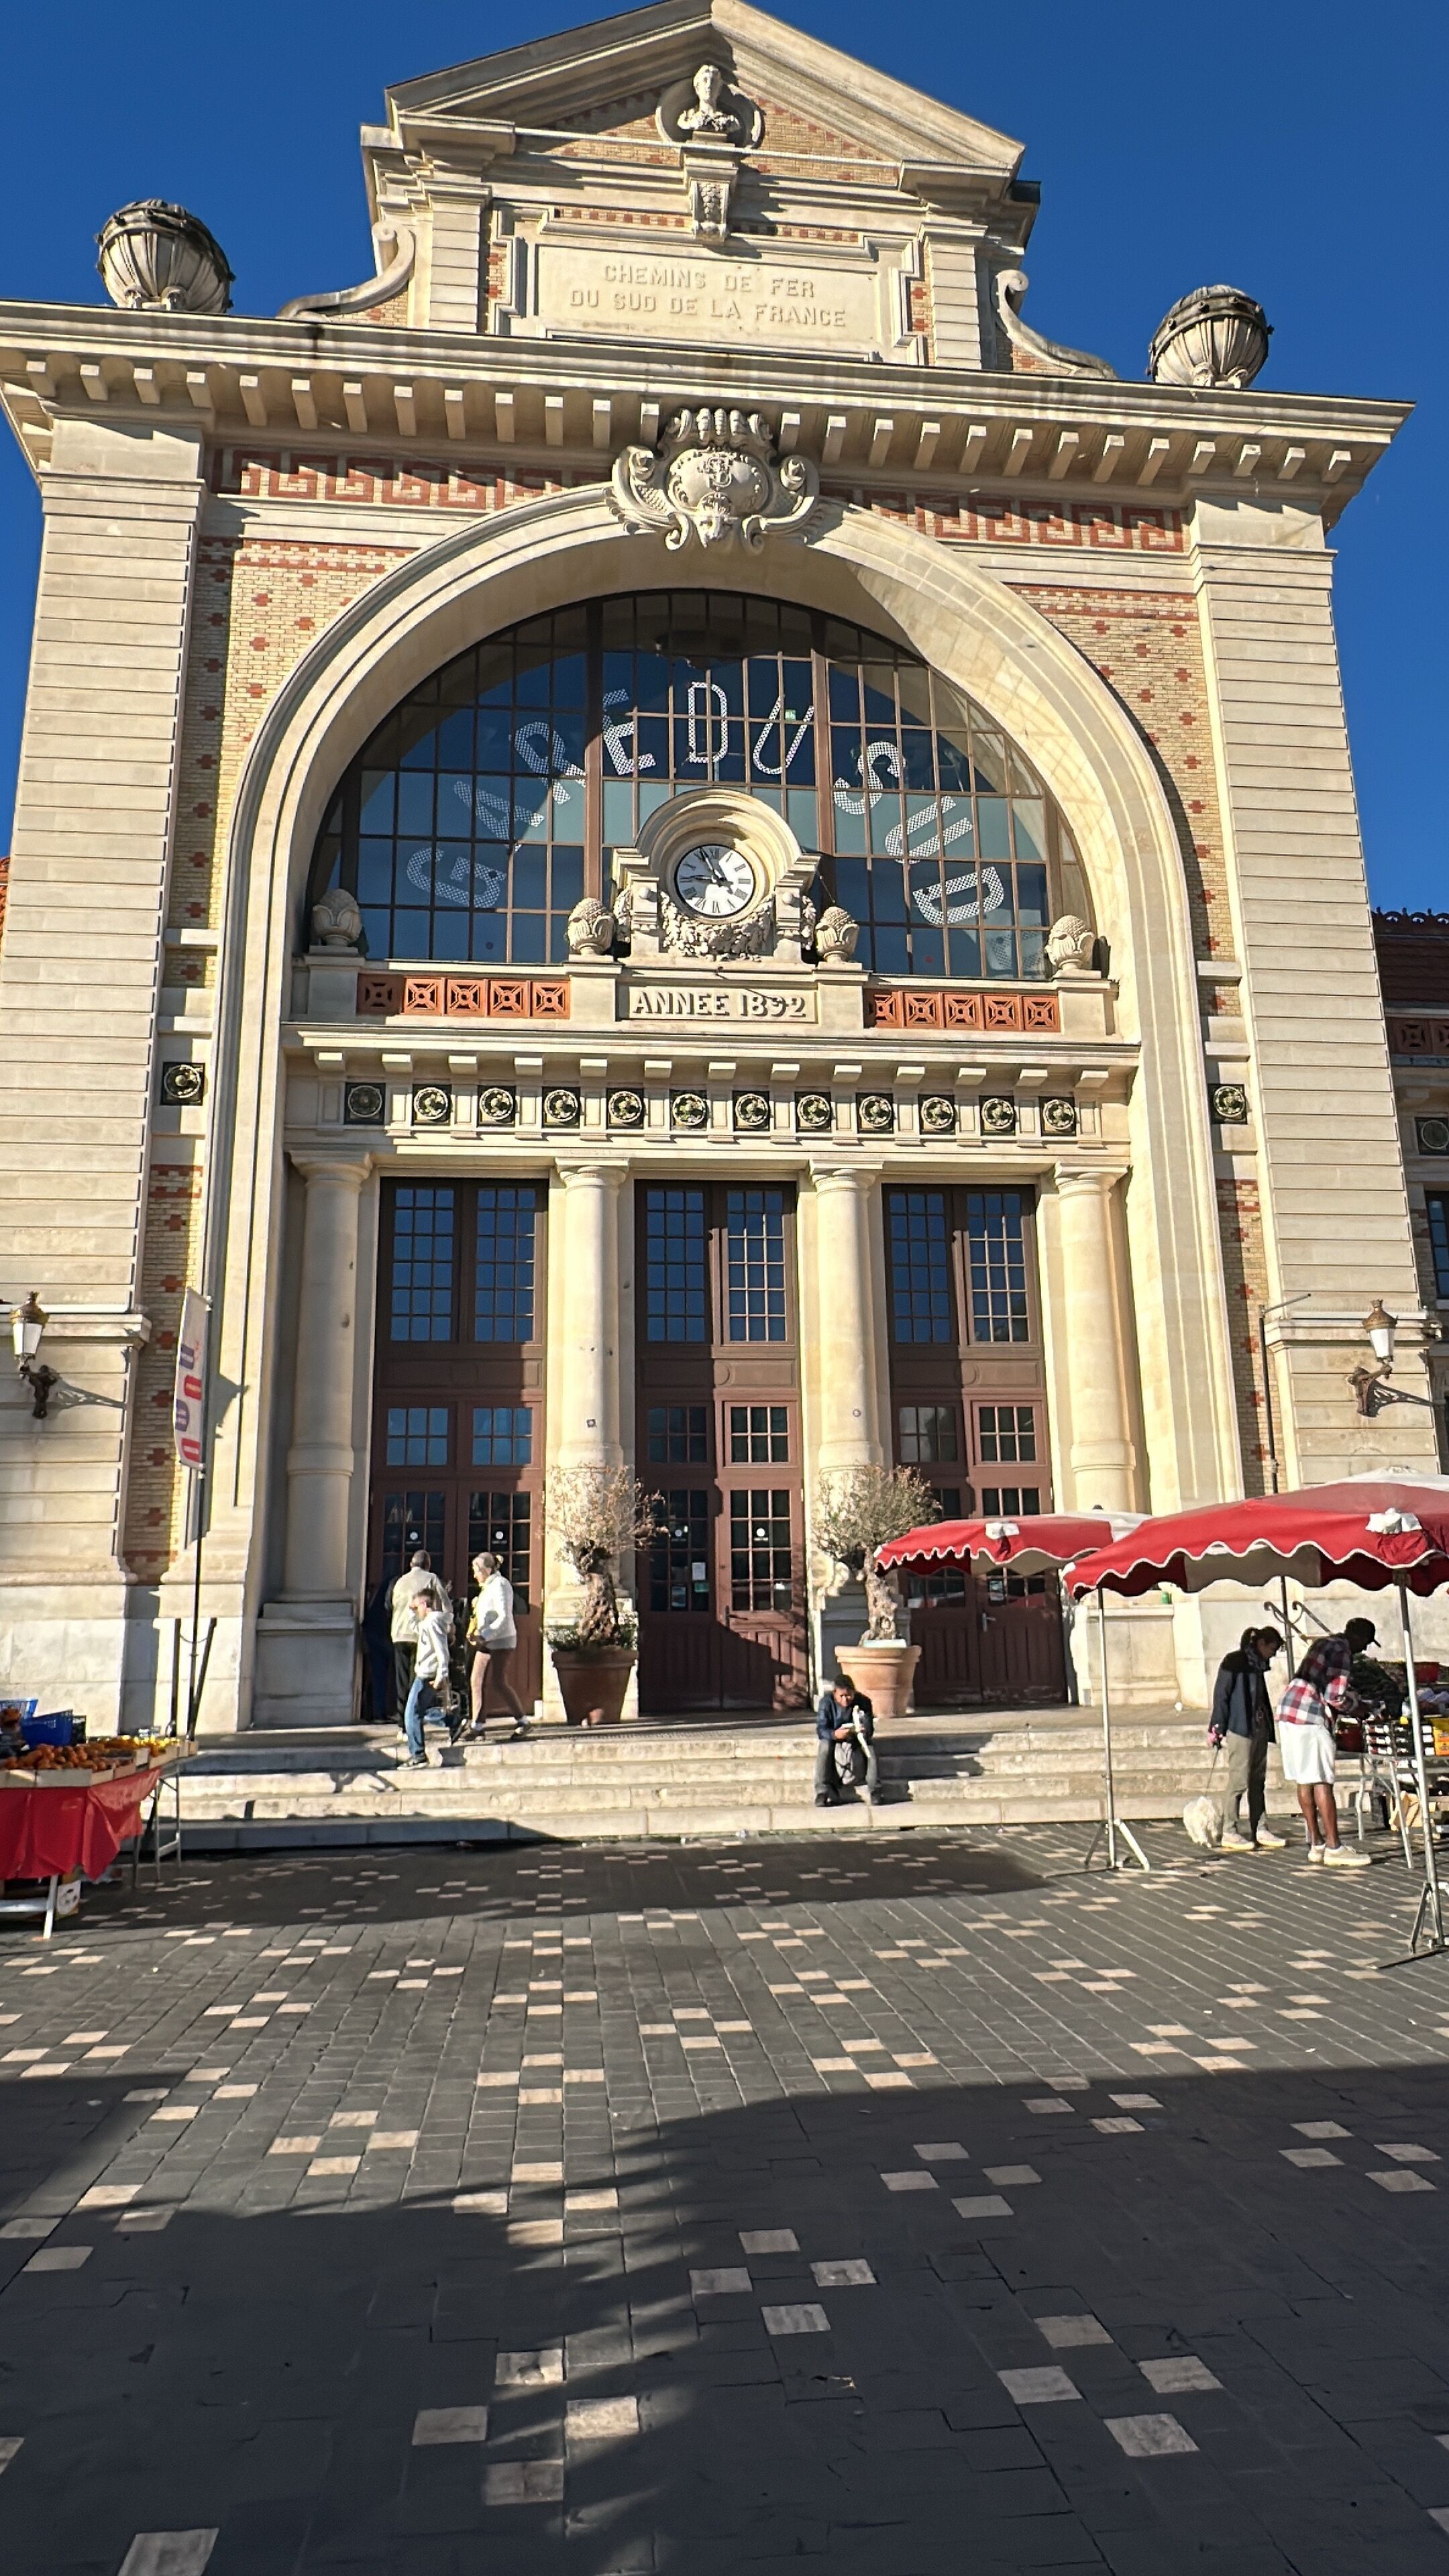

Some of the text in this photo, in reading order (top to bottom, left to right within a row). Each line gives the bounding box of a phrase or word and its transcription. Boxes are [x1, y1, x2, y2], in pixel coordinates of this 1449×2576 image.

[604, 264, 816, 297] CHEMINS DE FER
[570, 289, 847, 327] DU SUD DE LA FRANCE
[407, 681, 1005, 925] GARE DU SUD
[632, 991, 806, 1018] ANNEE 1892
